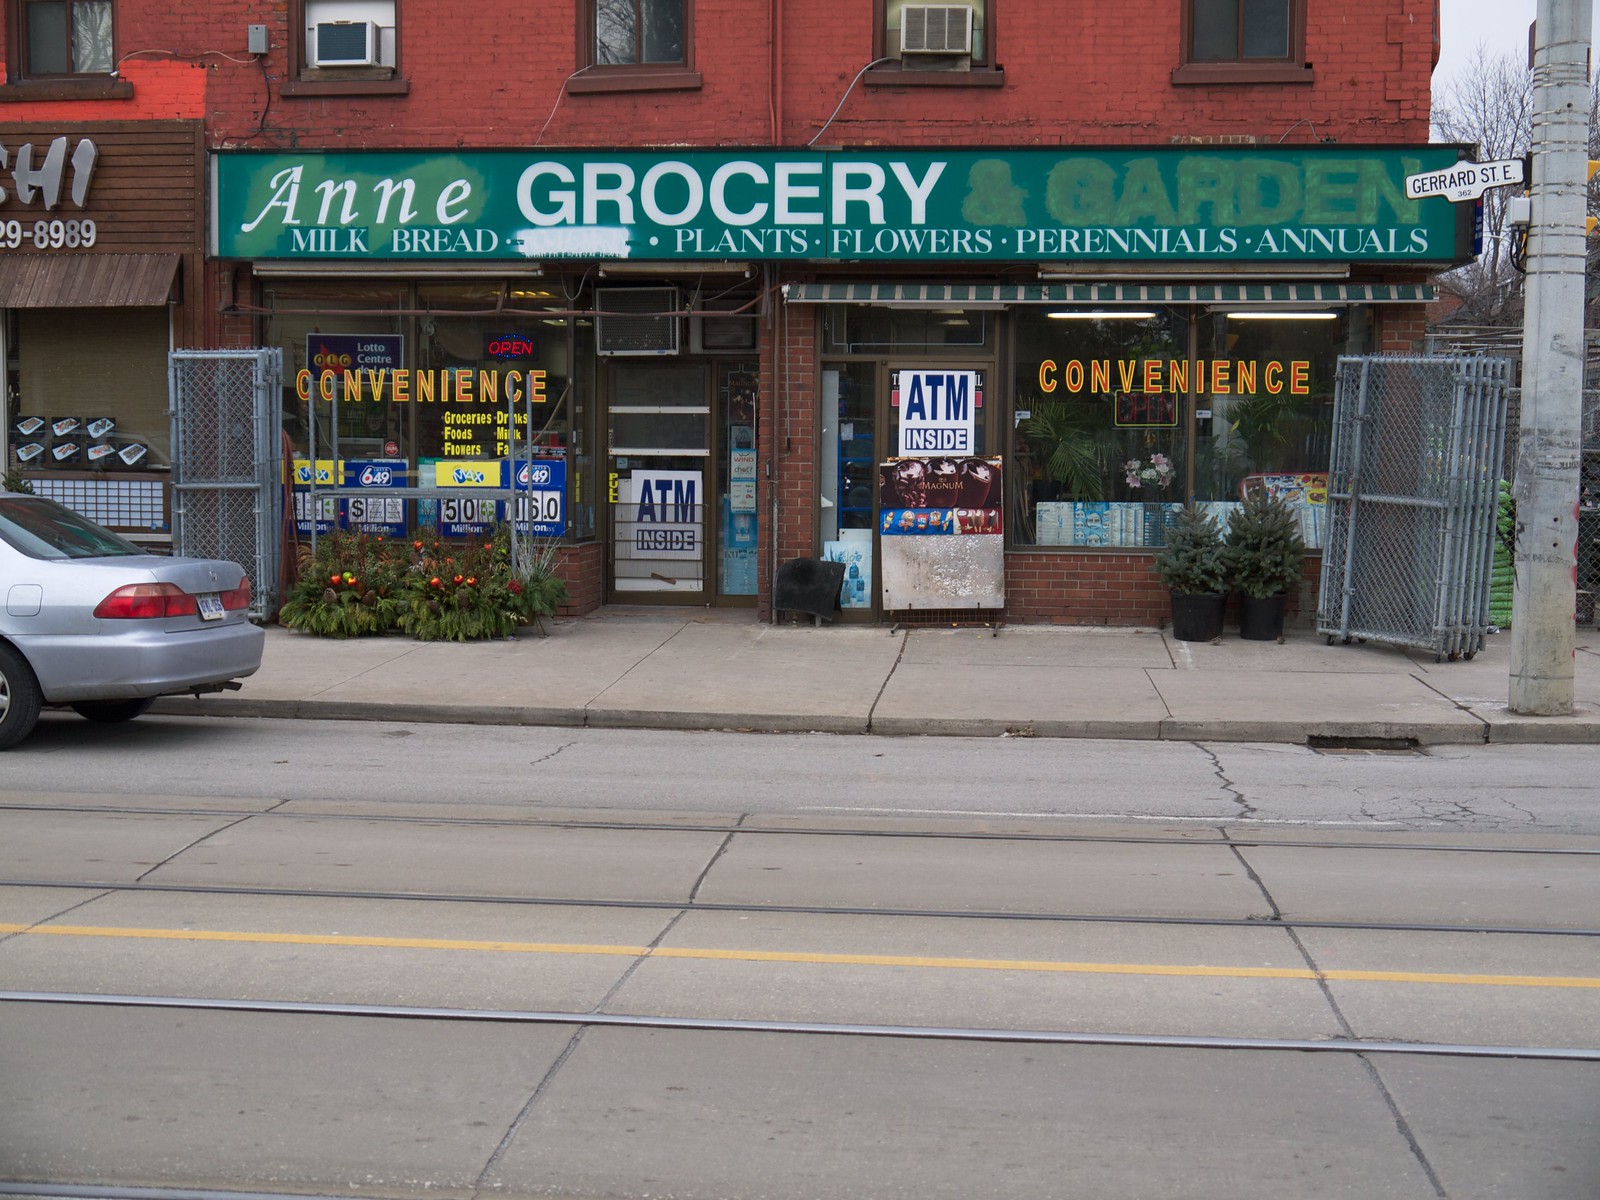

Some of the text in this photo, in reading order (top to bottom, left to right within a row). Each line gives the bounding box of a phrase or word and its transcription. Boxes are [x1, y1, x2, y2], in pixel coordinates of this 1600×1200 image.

[0, 136, 97, 211] HI
[1412, 164, 1516, 194] GERRARD ST. E.
[241, 165, 472, 233] Anne
[517, 161, 947, 226] GROCERY
[1457, 189, 1472, 198] 362
[291, 228, 1428, 253] MILK BREAD PLANTS FLOWERS PERENNIALS ANNUALS
[357, 343, 385, 352] Lotto
[488, 341, 533, 354] OPEN
[313, 353, 352, 367] OLG
[357, 354, 392, 364] Centre
[296, 368, 547, 403] CONVENIENCE
[1039, 359, 1310, 395] CONVENIENCE
[905, 374, 968, 421] ATM
[444, 411, 528, 425] Groceries Drnks
[444, 426, 472, 440] Foods
[906, 429, 967, 450] INSIDE
[444, 442, 481, 456] Flowers
[608, 472, 619, 504] PULL
[921, 482, 964, 490] MAGNUM
[637, 479, 695, 523] ATM
[451, 525, 482, 533] Million
[637, 530, 694, 550] INSIDE
